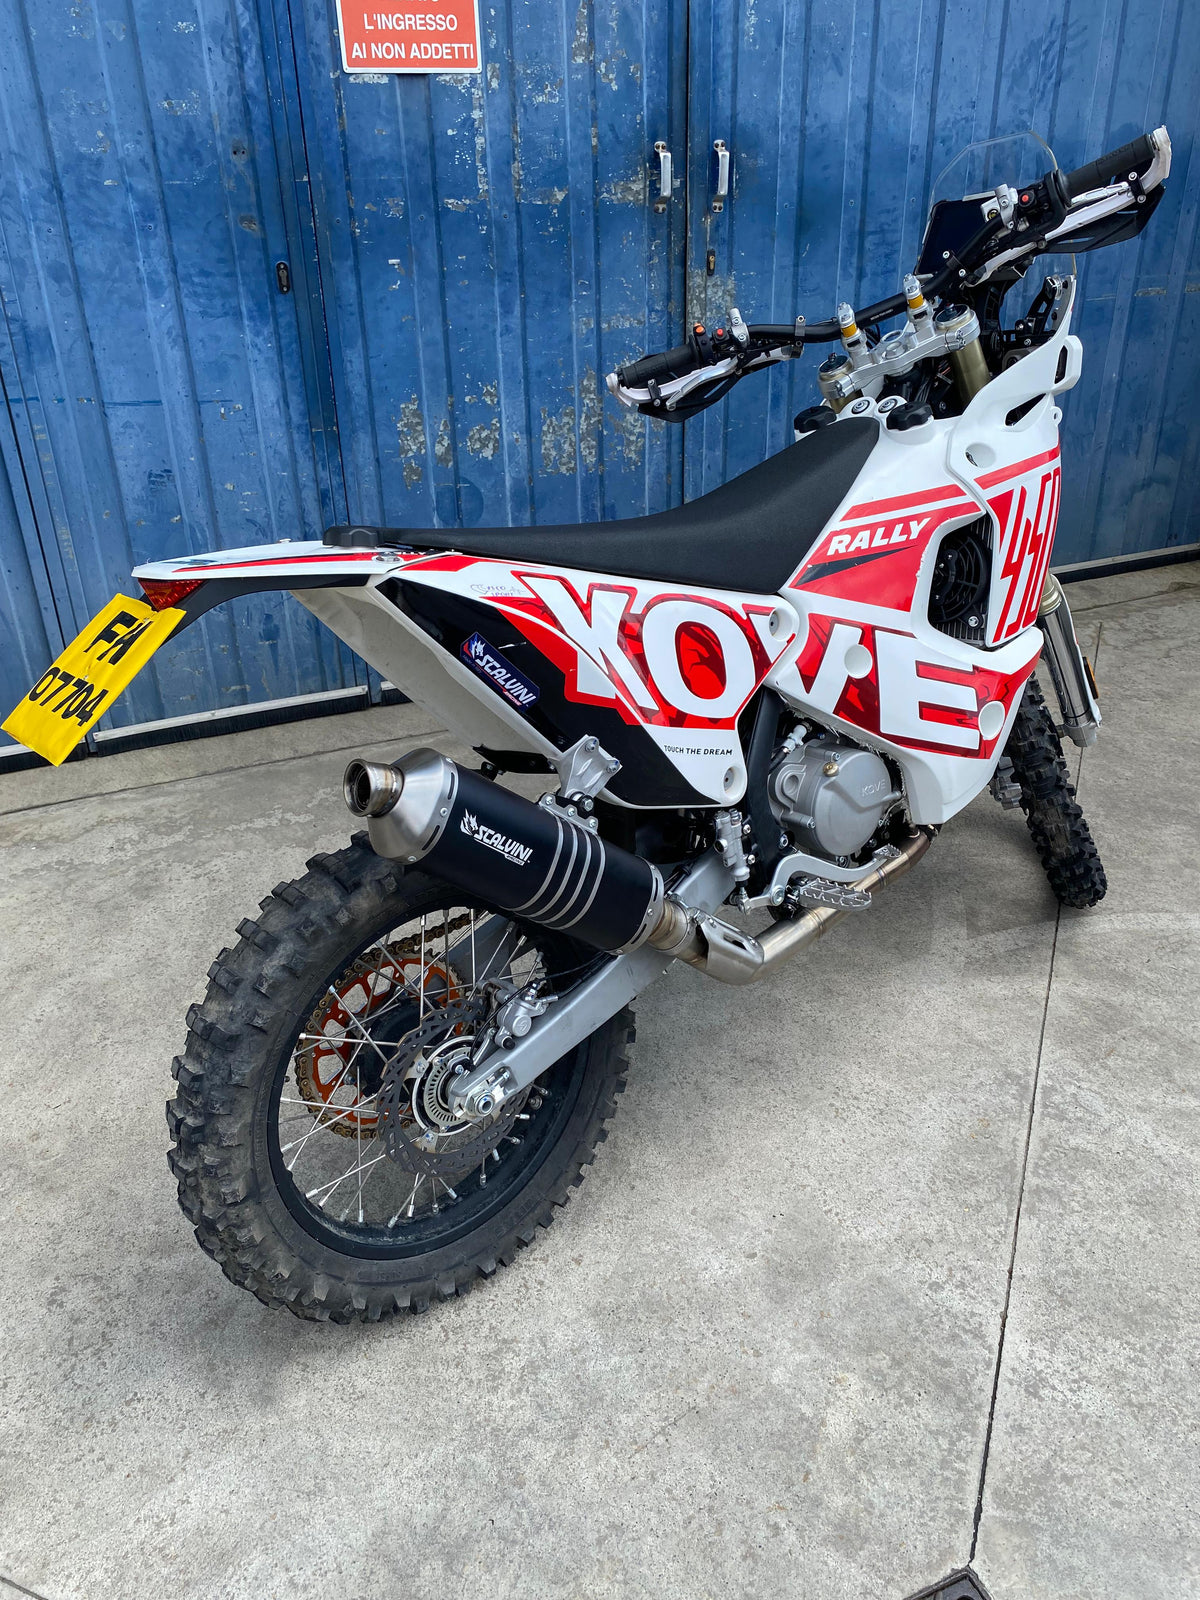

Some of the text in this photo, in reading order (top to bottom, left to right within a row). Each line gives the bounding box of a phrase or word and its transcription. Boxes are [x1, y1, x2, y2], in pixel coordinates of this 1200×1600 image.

[363, 13, 458, 31] L'INGRESSO
[351, 42, 474, 59] AI NON ADDETTI
[826, 517, 931, 556] RALLY
[475, 654, 536, 705] SCALVINI
[517, 574, 981, 753] KOVE
[28, 666, 109, 727] 07704
[664, 745, 733, 756] TOUCH THE DREAM
[861, 779, 886, 797] KOVE
[473, 825, 533, 861] SCALVINI
